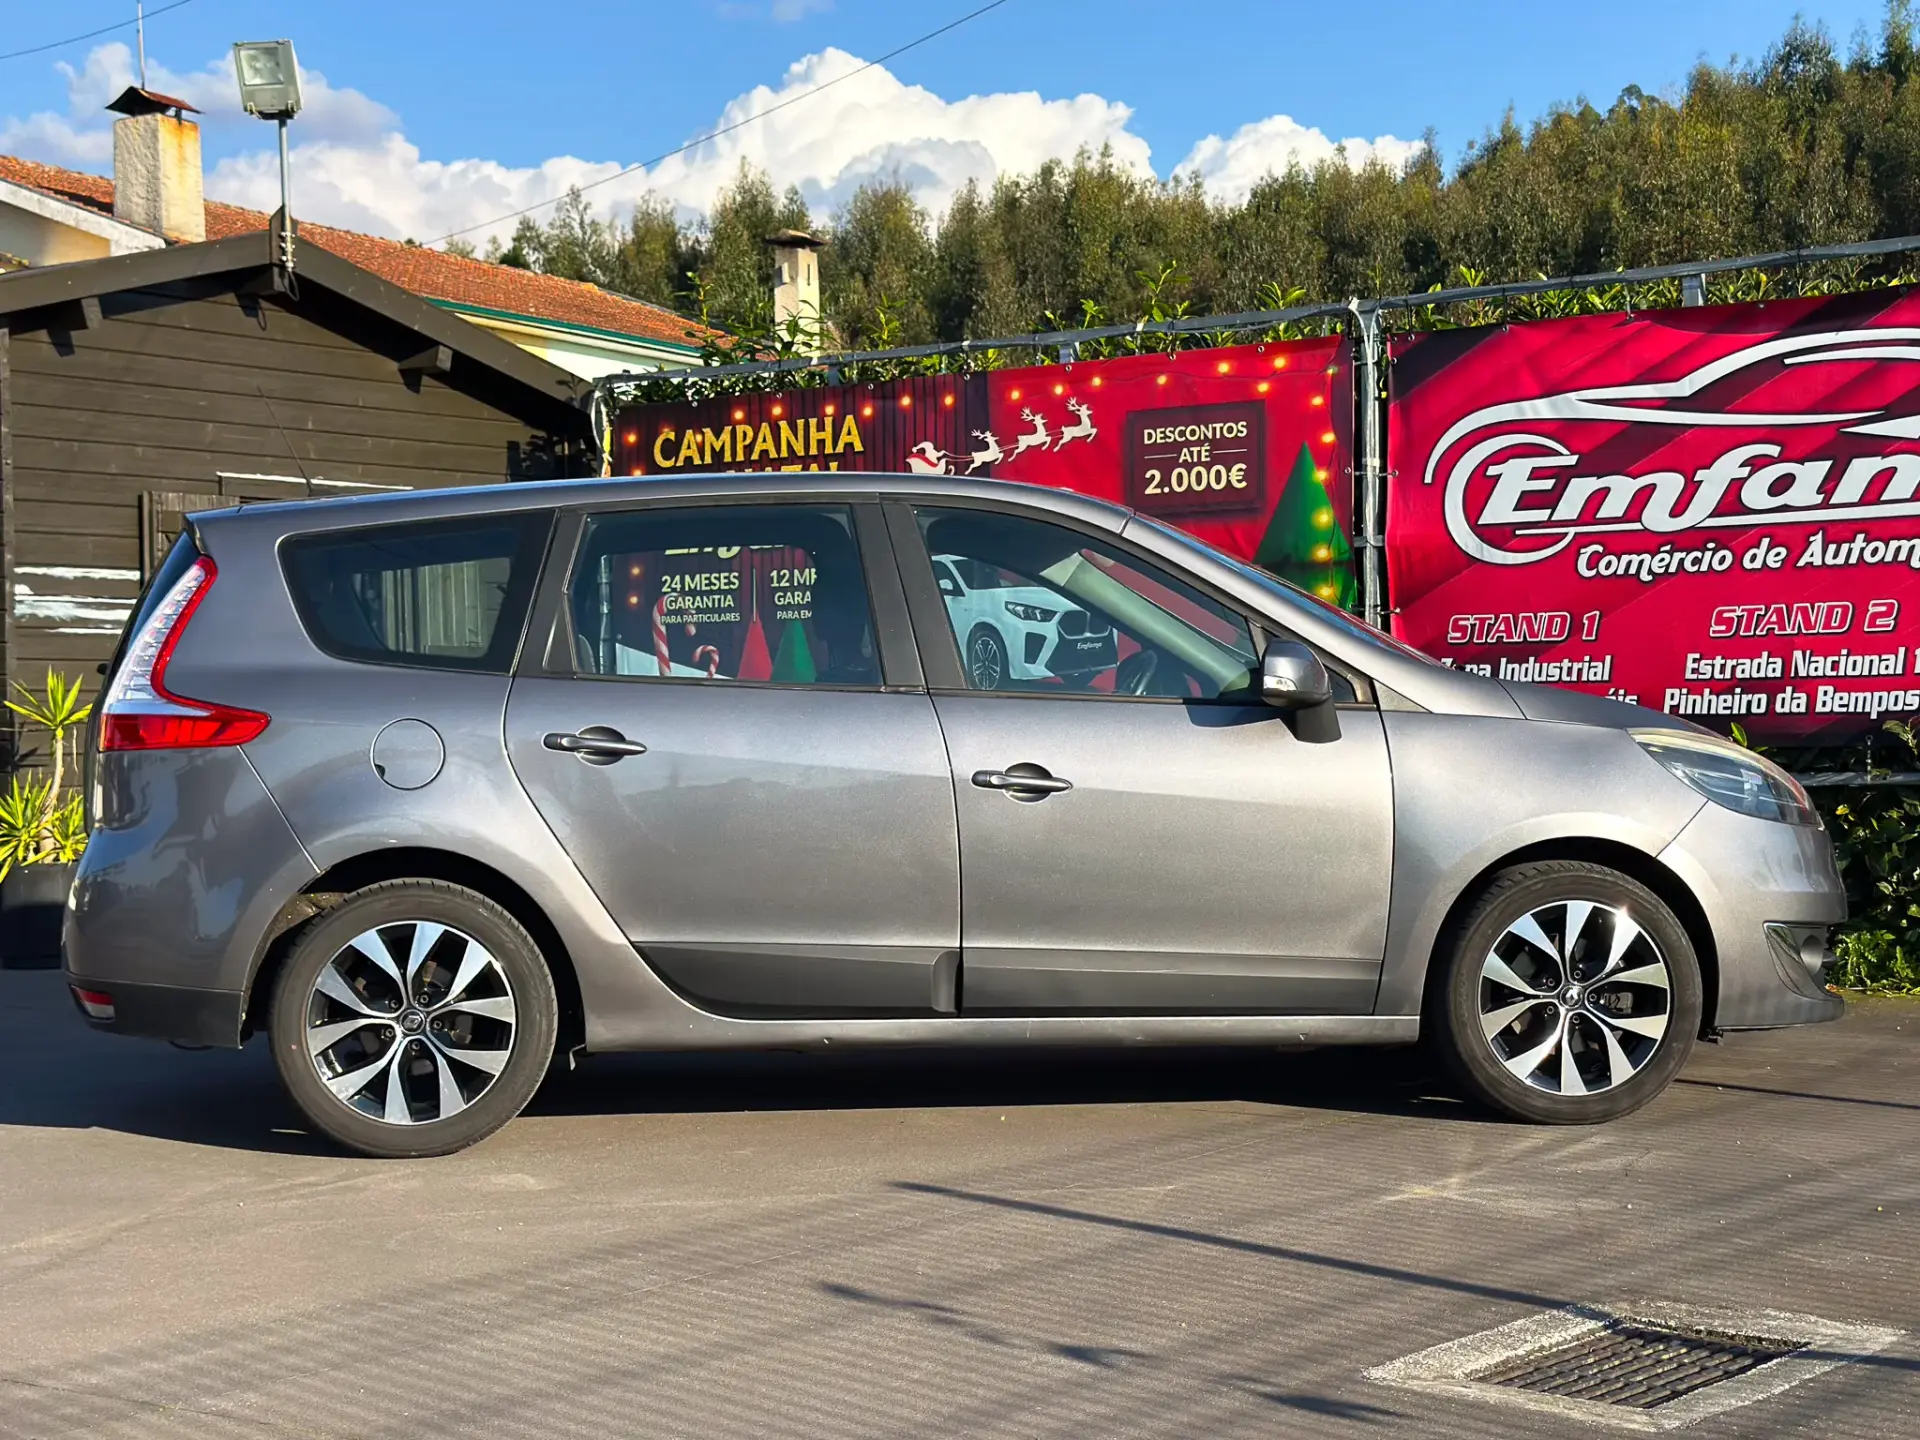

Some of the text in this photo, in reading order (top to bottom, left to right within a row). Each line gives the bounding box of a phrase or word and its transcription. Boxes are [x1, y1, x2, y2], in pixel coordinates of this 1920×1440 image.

[653, 414, 864, 468] CAMPANHA
[1144, 421, 1247, 445] DESCONTOS
[1178, 443, 1211, 463] ATÉ
[1144, 463, 1248, 495] 2.000€
[1577, 529, 1920, 582] Comércio de Autom
[661, 572, 740, 592] 24 MESES
[770, 569, 790, 587] 12
[666, 594, 735, 610] GARANTIA
[774, 590, 812, 606] GARA
[661, 612, 740, 624] PARA PARTICULARES
[777, 610, 799, 620] PARA
[1447, 610, 1600, 643] STAND 1
[1709, 599, 1898, 637] STAND 2
[1499, 655, 1612, 682] Industrial
[1684, 651, 1783, 679] Estrada
[1790, 646, 1905, 677] Nacional
[1663, 686, 1768, 714] Pinheiro
[1775, 685, 1807, 714] da
[1815, 685, 1920, 719] Bempos
